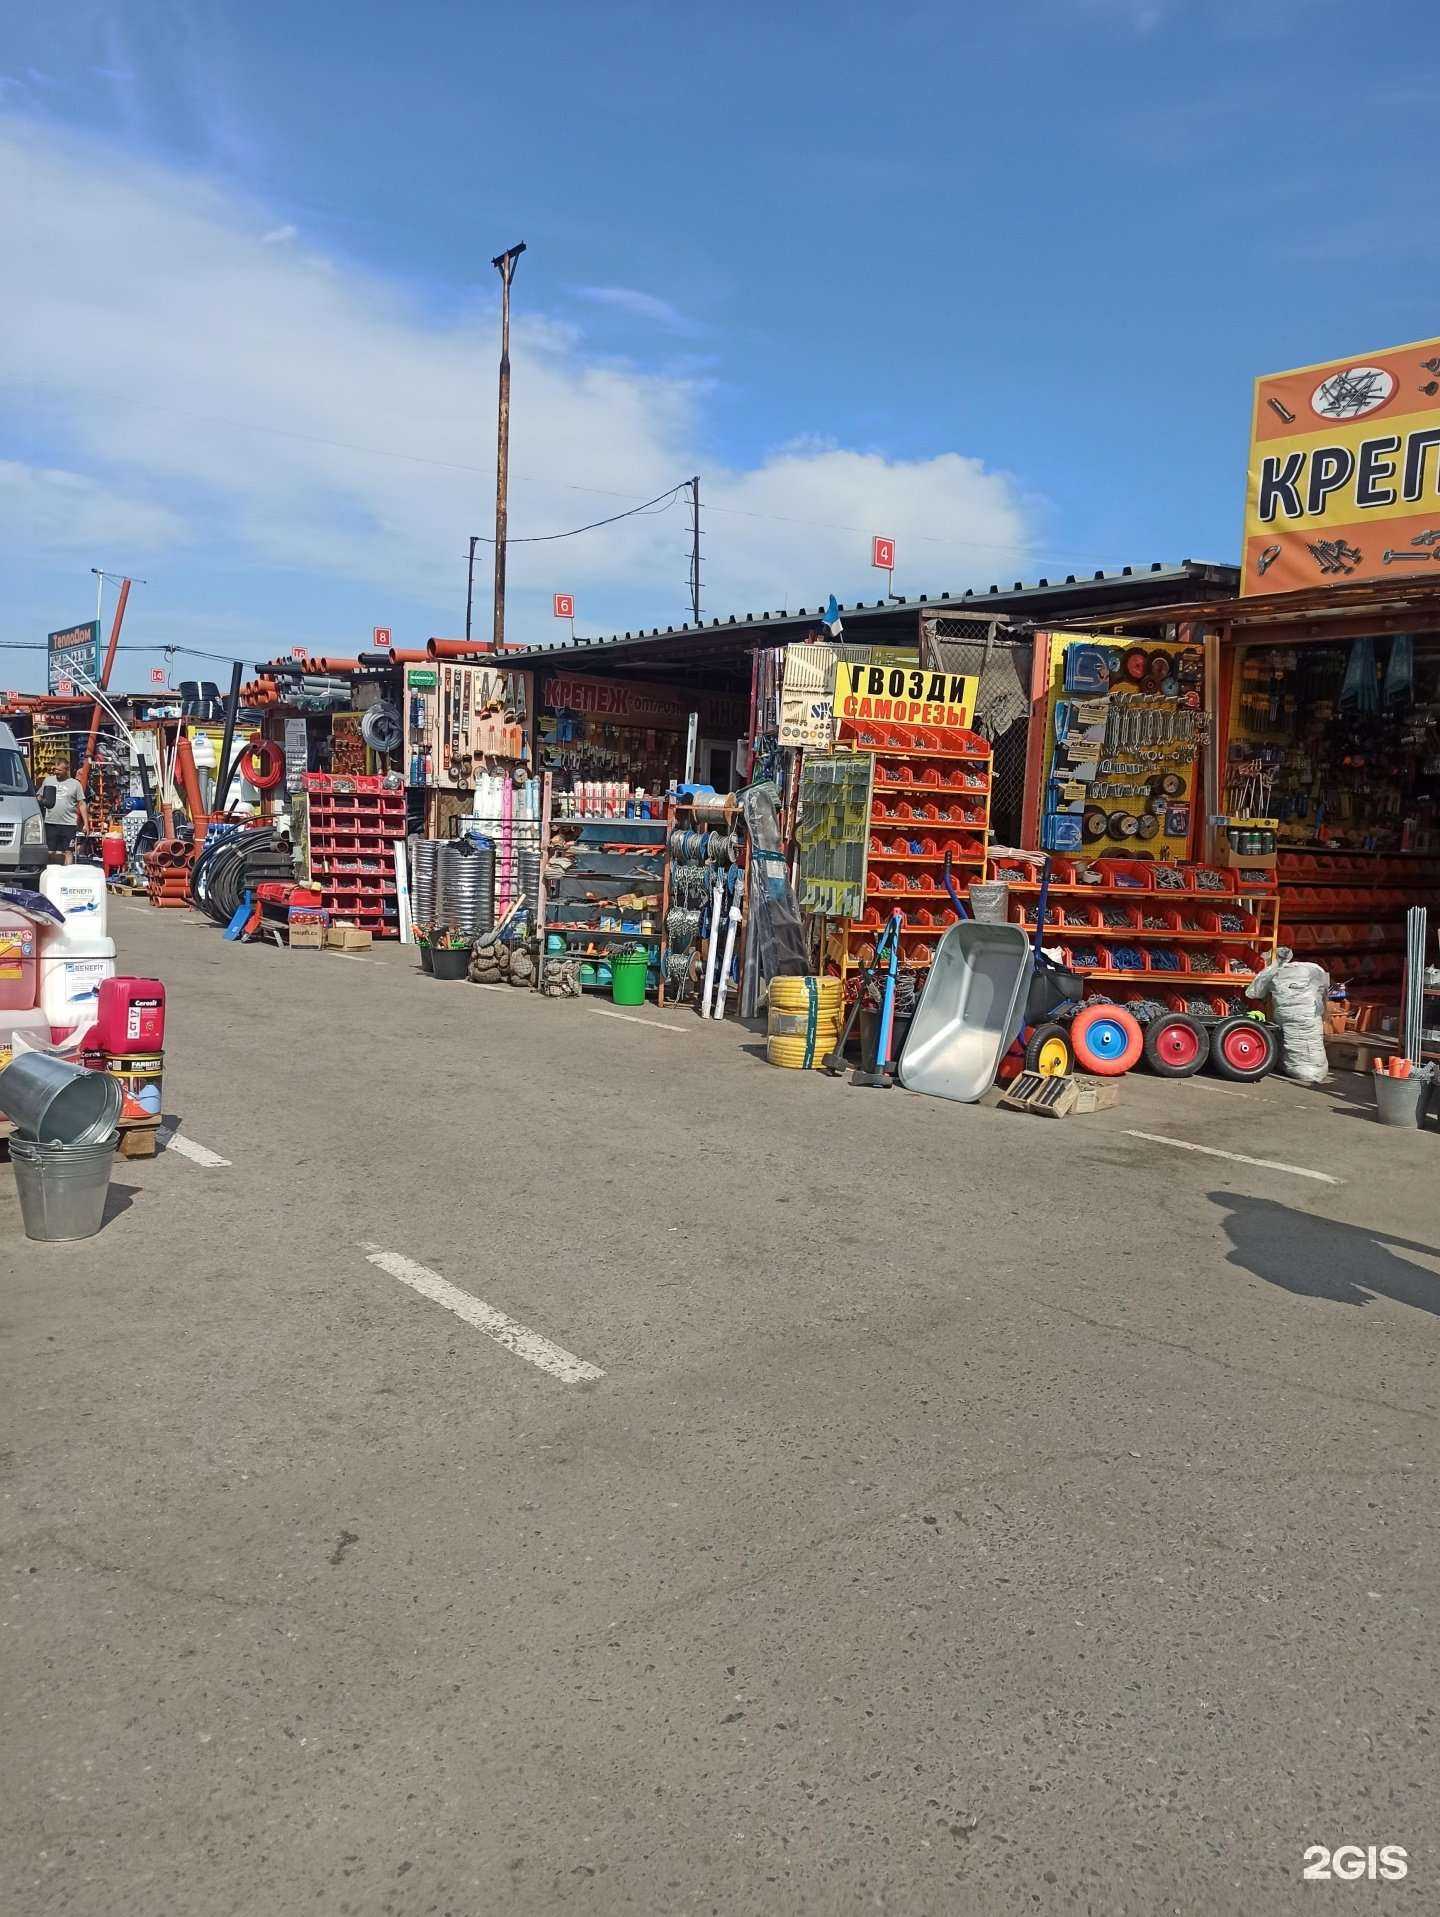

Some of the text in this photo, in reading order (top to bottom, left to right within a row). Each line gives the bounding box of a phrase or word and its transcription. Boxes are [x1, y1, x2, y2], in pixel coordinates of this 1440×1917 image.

[880, 545, 889, 561] 4
[560, 599, 569, 612] 6
[379, 632, 386, 643] 8
[851, 664, 966, 704] ГВОЗДИ
[544, 678, 629, 715] КРЕПЕЖ
[843, 694, 967, 728] САМОРЕЗЫ
[75, 963, 104, 972] BENEFIT
